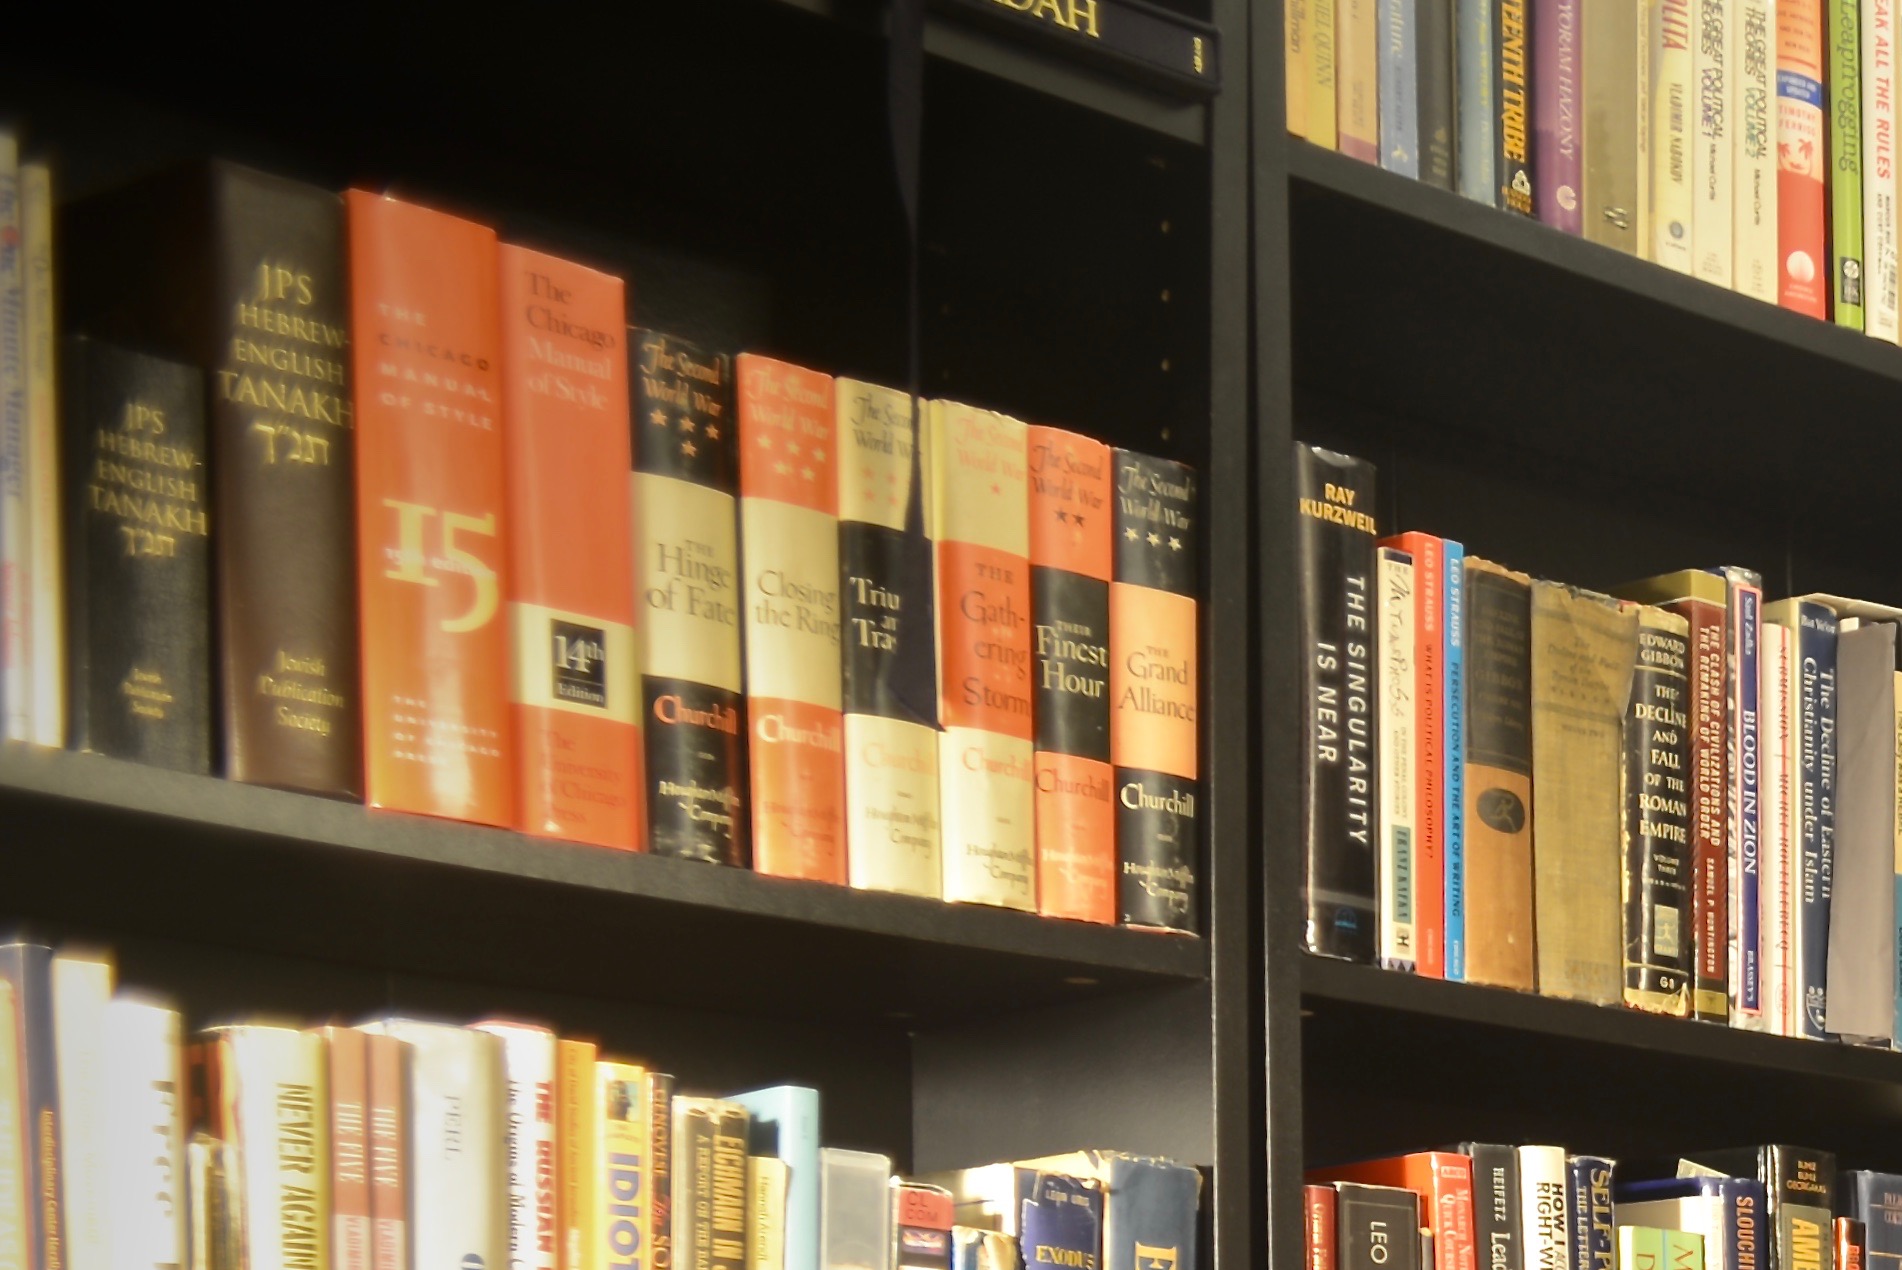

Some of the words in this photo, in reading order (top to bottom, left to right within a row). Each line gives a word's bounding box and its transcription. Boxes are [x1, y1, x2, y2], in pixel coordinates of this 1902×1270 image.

[260, 264, 312, 305] JPS
[234, 339, 345, 385] ENGLISH
[218, 371, 354, 429] TANAKH
[1300, 498, 1377, 535] KURZWEIL
[1324, 482, 1355, 505] RAY
[385, 498, 496, 633] 15
[1347, 575, 1365, 629] THE
[1036, 622, 1108, 667] Finest
[1317, 642, 1337, 670] IS
[1042, 661, 1104, 697] Hour
[1318, 682, 1337, 764] NEAR
[1347, 639, 1367, 845] SINGULARITY
[1743, 710, 1755, 783] BLOOD
[1744, 790, 1755, 811] IN
[1744, 817, 1756, 875] ZION
[277, 1083, 312, 1174] NEVER
[1370, 1221, 1387, 1264] LEO
